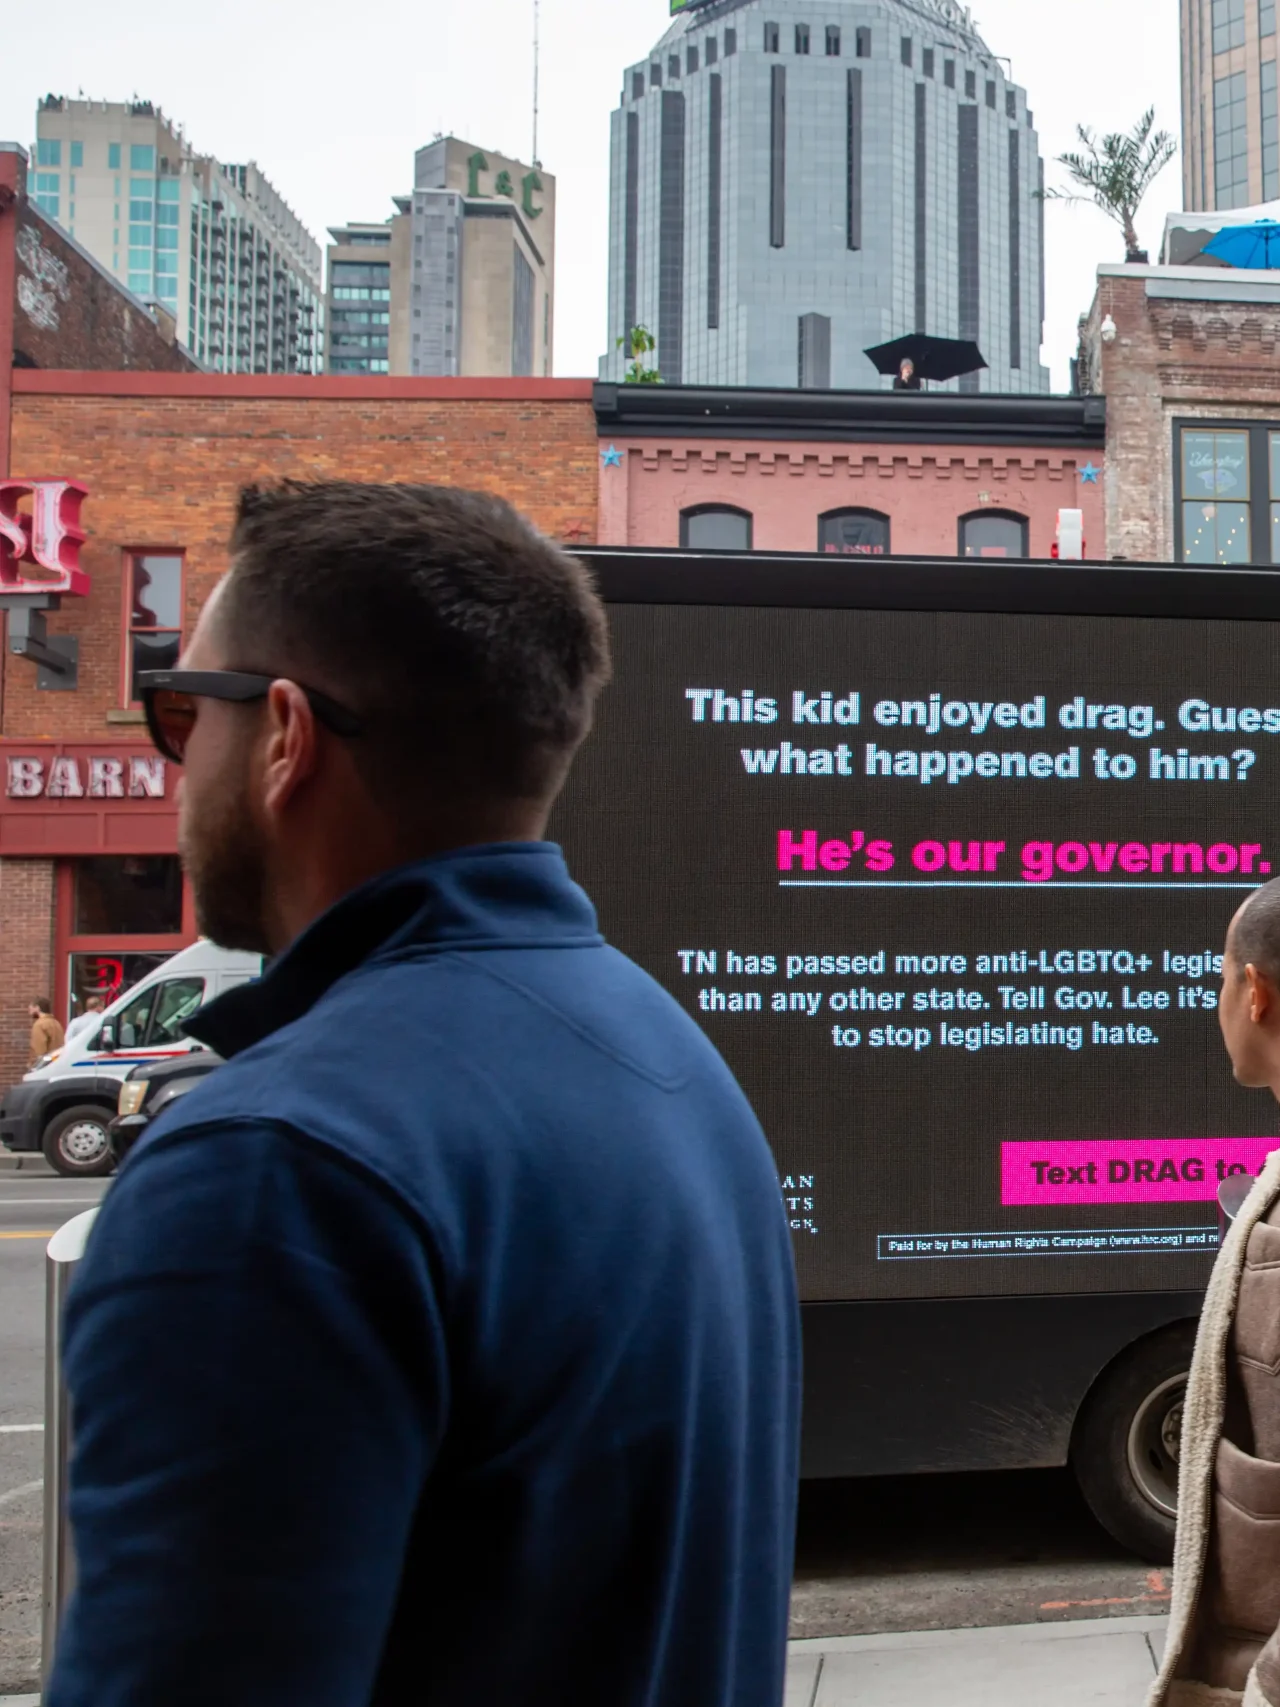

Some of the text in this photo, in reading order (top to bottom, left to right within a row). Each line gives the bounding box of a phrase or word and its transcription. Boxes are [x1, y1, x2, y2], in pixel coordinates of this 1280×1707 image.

[685, 688, 778, 724] This
[792, 691, 860, 726] kid
[874, 693, 1045, 734] enjoyed
[1059, 697, 1165, 737] drag.
[5, 756, 166, 798] BARN
[740, 742, 1256, 784] what happened to him?
[778, 830, 1270, 881] He's our governor.
[677, 950, 1224, 978] TN has passed more anti-LGBTQ+ legis
[698, 985, 1218, 1016] than any other state. Tell Gov. Lee it's
[832, 1021, 1159, 1051] to stop legislating hate.
[1031, 1160, 1097, 1184] Text
[1109, 1158, 1204, 1183] DRAG
[888, 1240, 914, 1252] Paid
[916, 1240, 933, 1251] for
[934, 1239, 949, 1252] by
[951, 1239, 969, 1250] the
[971, 1238, 1012, 1249] Human
[1014, 1237, 1049, 1250] Rights
[1051, 1236, 1108, 1248] Campaign
[1185, 1233, 1206, 1244] and
